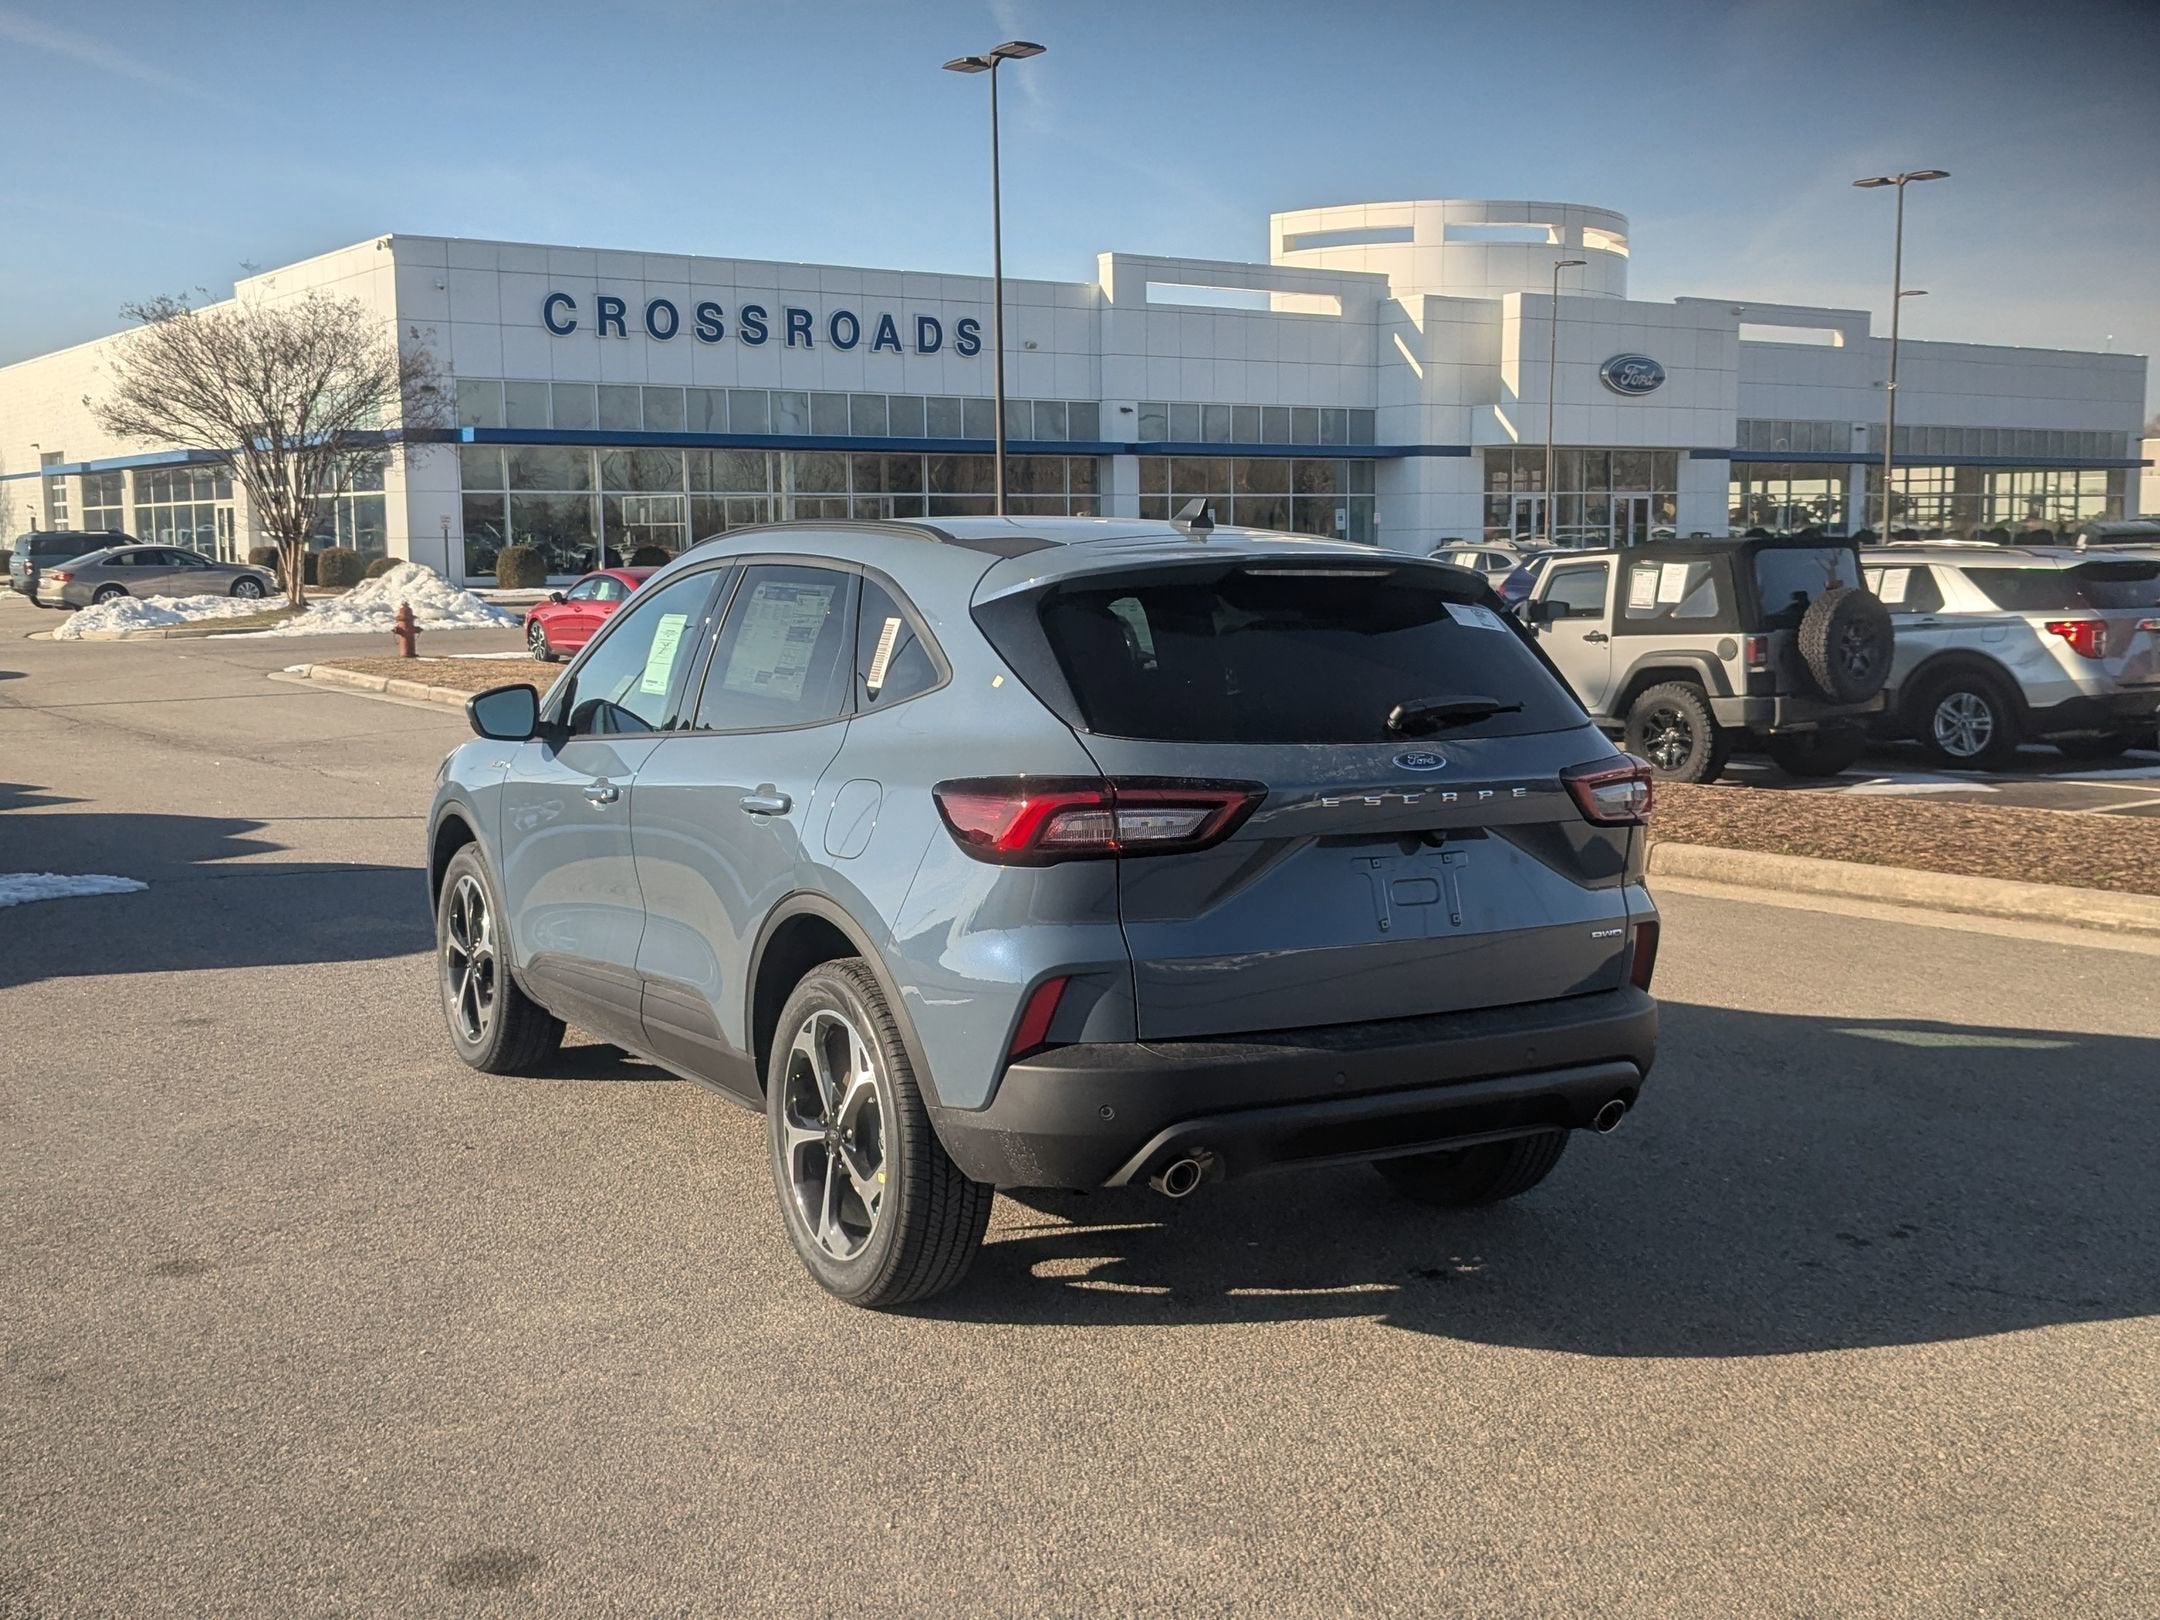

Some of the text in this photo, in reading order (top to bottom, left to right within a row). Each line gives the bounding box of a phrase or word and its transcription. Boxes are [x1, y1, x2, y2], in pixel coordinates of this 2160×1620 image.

[542, 292, 983, 358] CROSSROADS
[1620, 363, 1656, 386] Ford
[1407, 753, 1436, 765] Ford
[1321, 787, 1527, 808] ESCAPE
